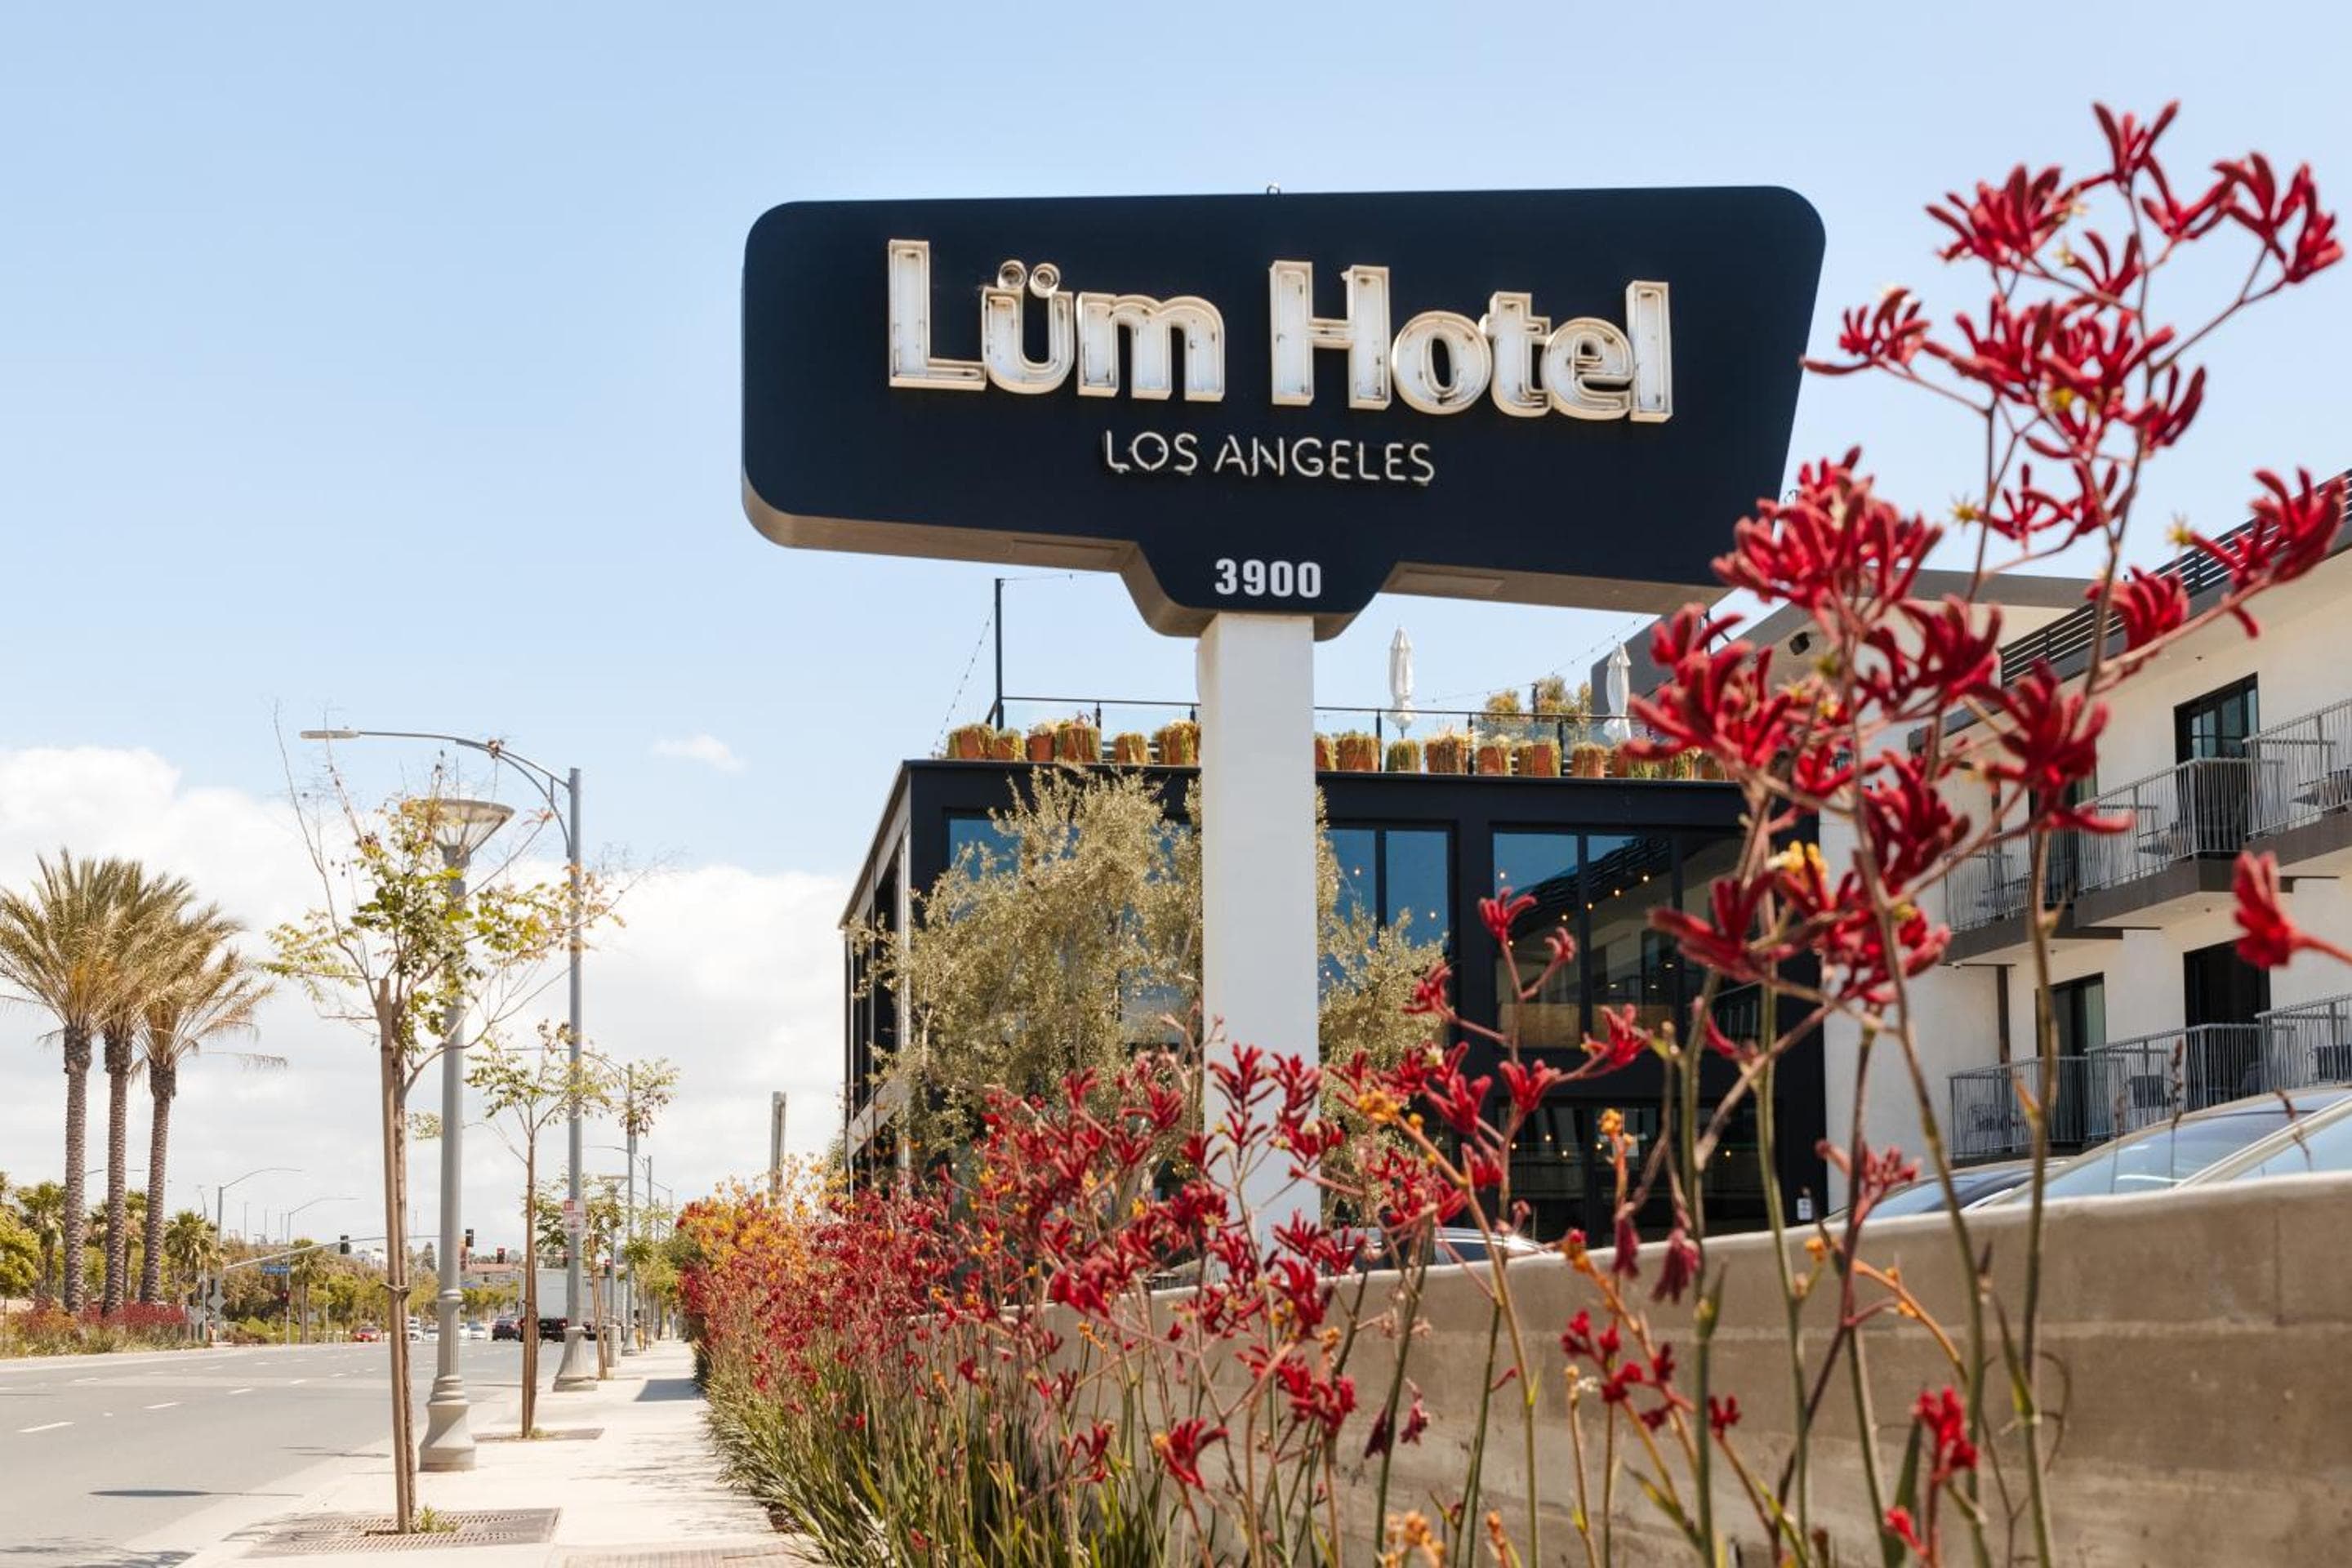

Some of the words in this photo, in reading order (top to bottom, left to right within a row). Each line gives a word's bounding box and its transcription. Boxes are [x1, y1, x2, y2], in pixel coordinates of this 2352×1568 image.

[889, 238, 1225, 403] Lüm
[1269, 259, 1673, 423] Hotel
[1104, 430, 1198, 474] LOS
[1214, 434, 1436, 485] ANGELES
[1214, 558, 1321, 599] 3900
